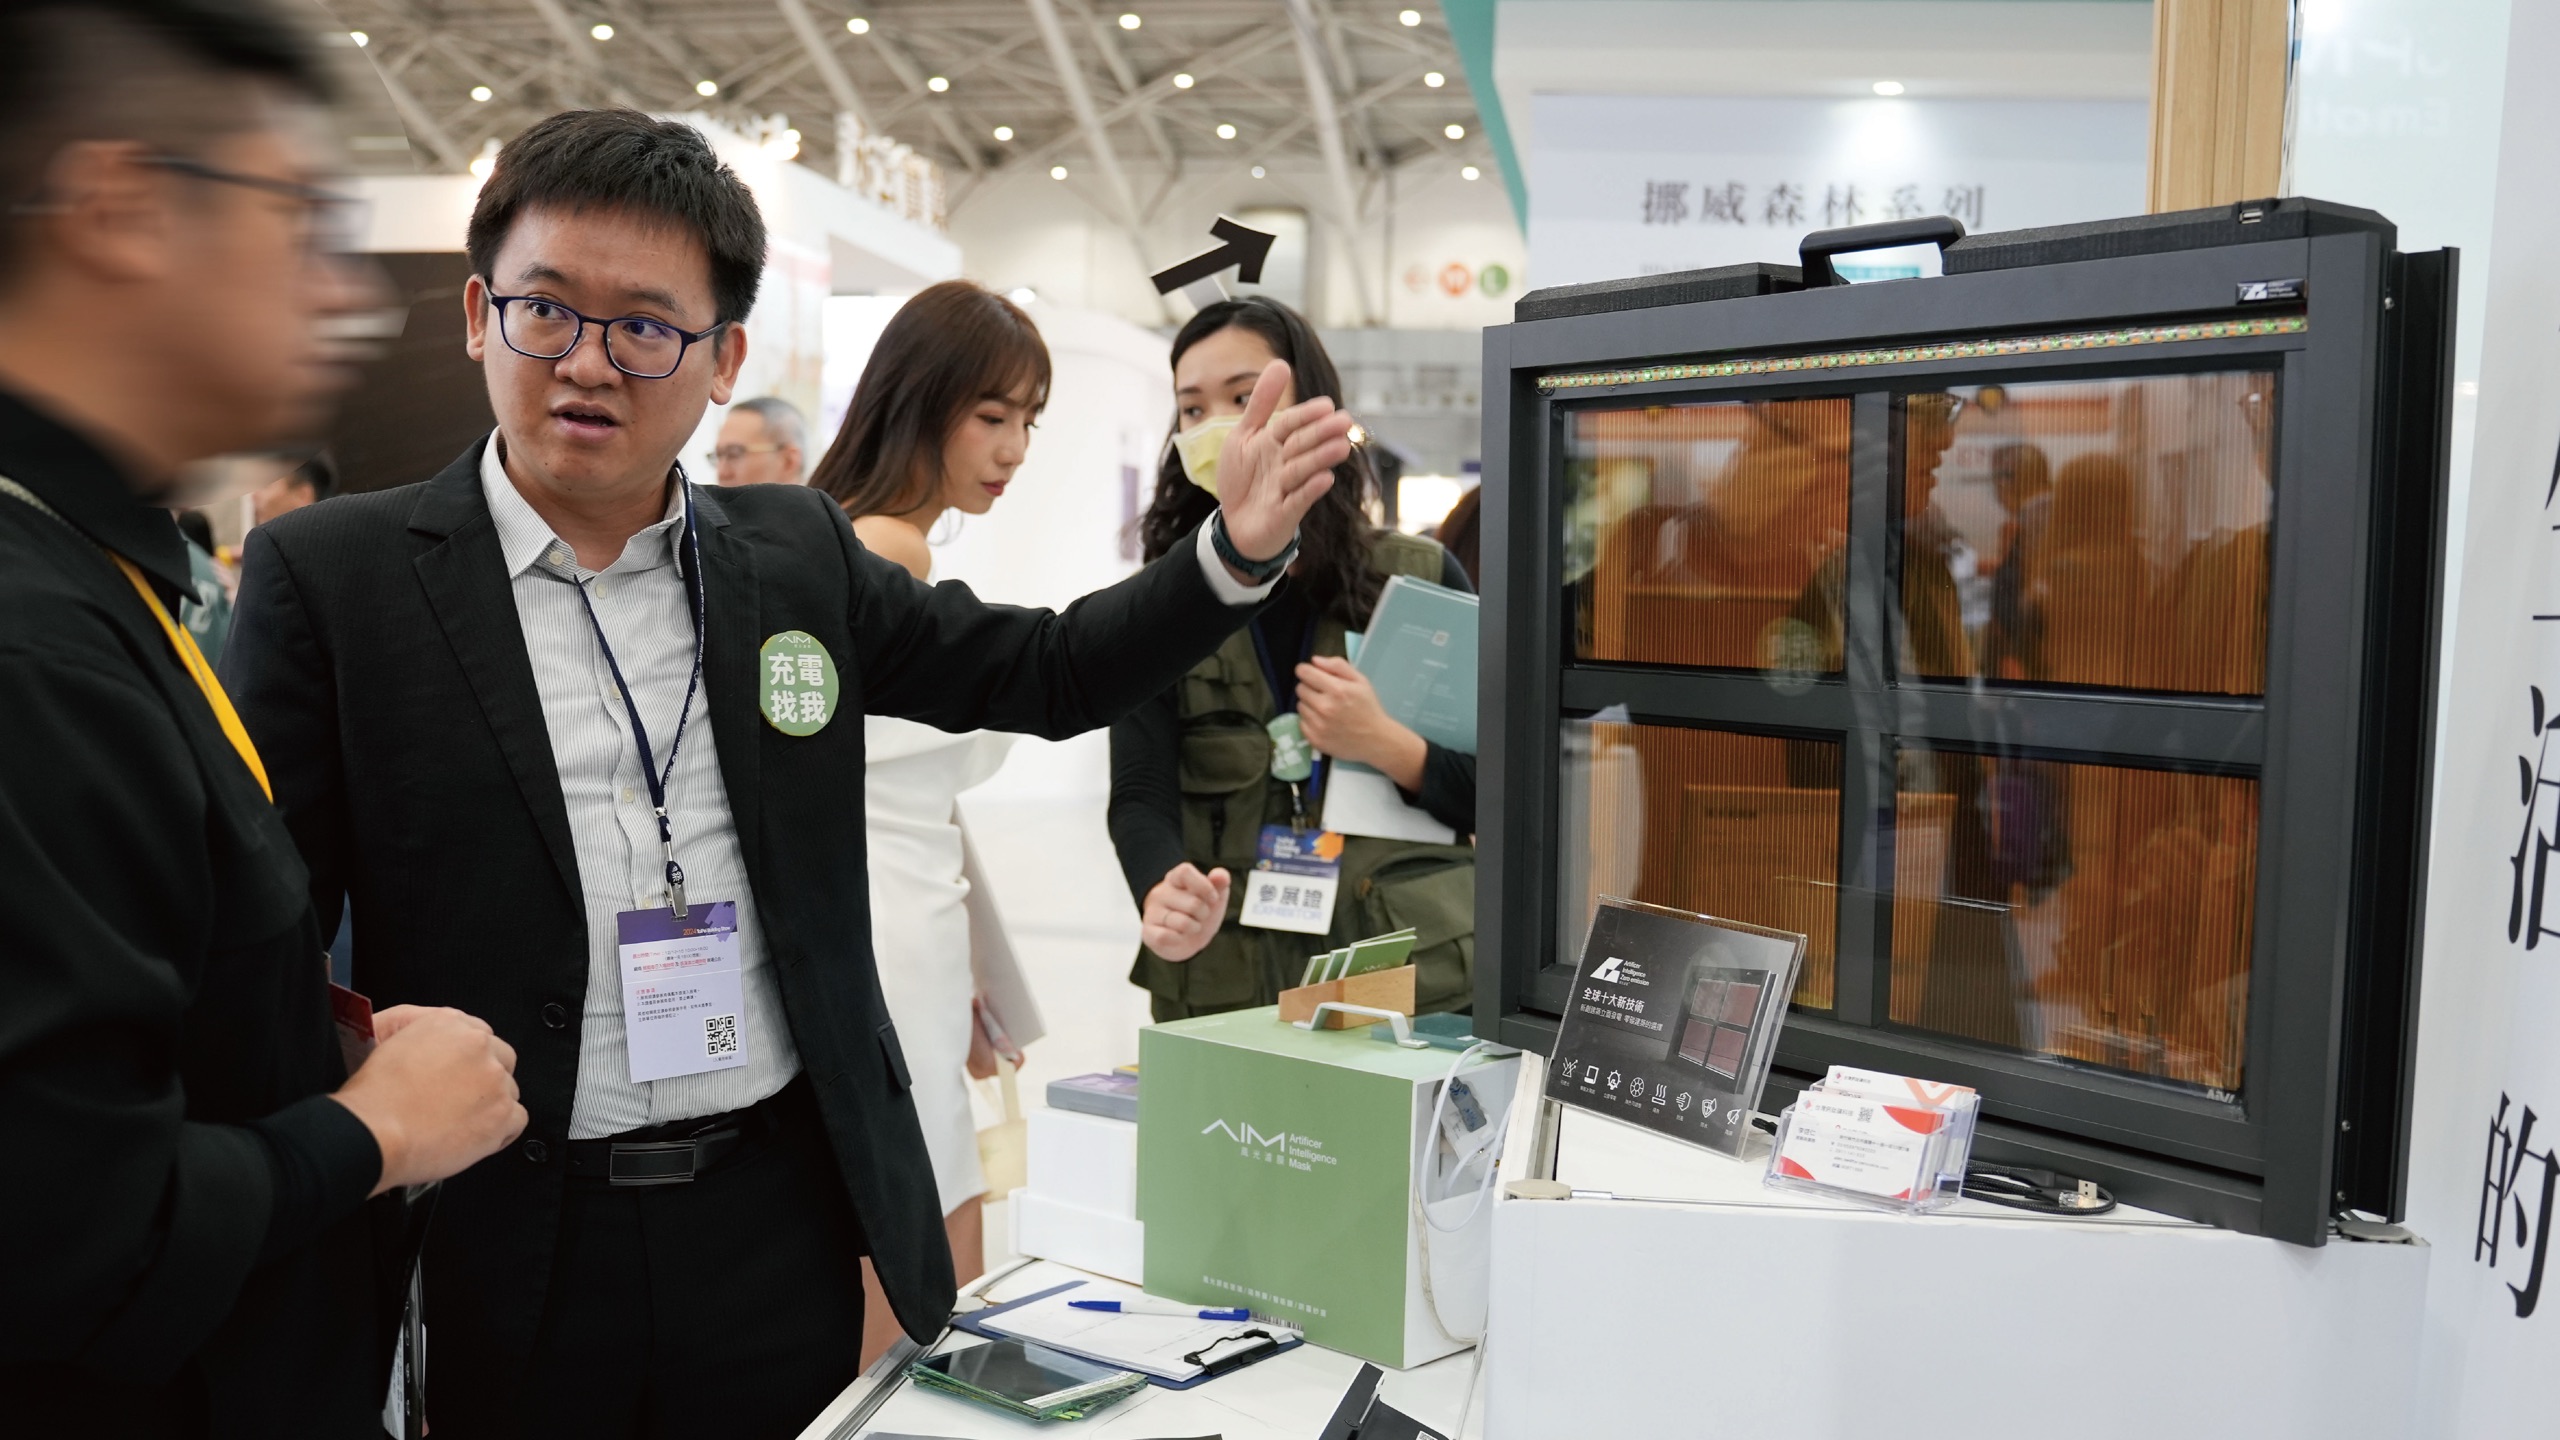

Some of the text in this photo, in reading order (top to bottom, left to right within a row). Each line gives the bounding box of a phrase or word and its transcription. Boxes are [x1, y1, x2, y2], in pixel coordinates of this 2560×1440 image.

[1643, 180, 1986, 229] 挪威森林系列
[768, 652, 824, 686] 充電
[771, 690, 827, 724] 找我
[1259, 885, 1323, 909] 參展證
[1582, 987, 1645, 1014] 全球十大新技術
[1201, 1118, 1322, 1152] AIM Artificer
[1288, 1145, 1337, 1165] Intelligence
[1288, 1158, 1312, 1172] Mask
